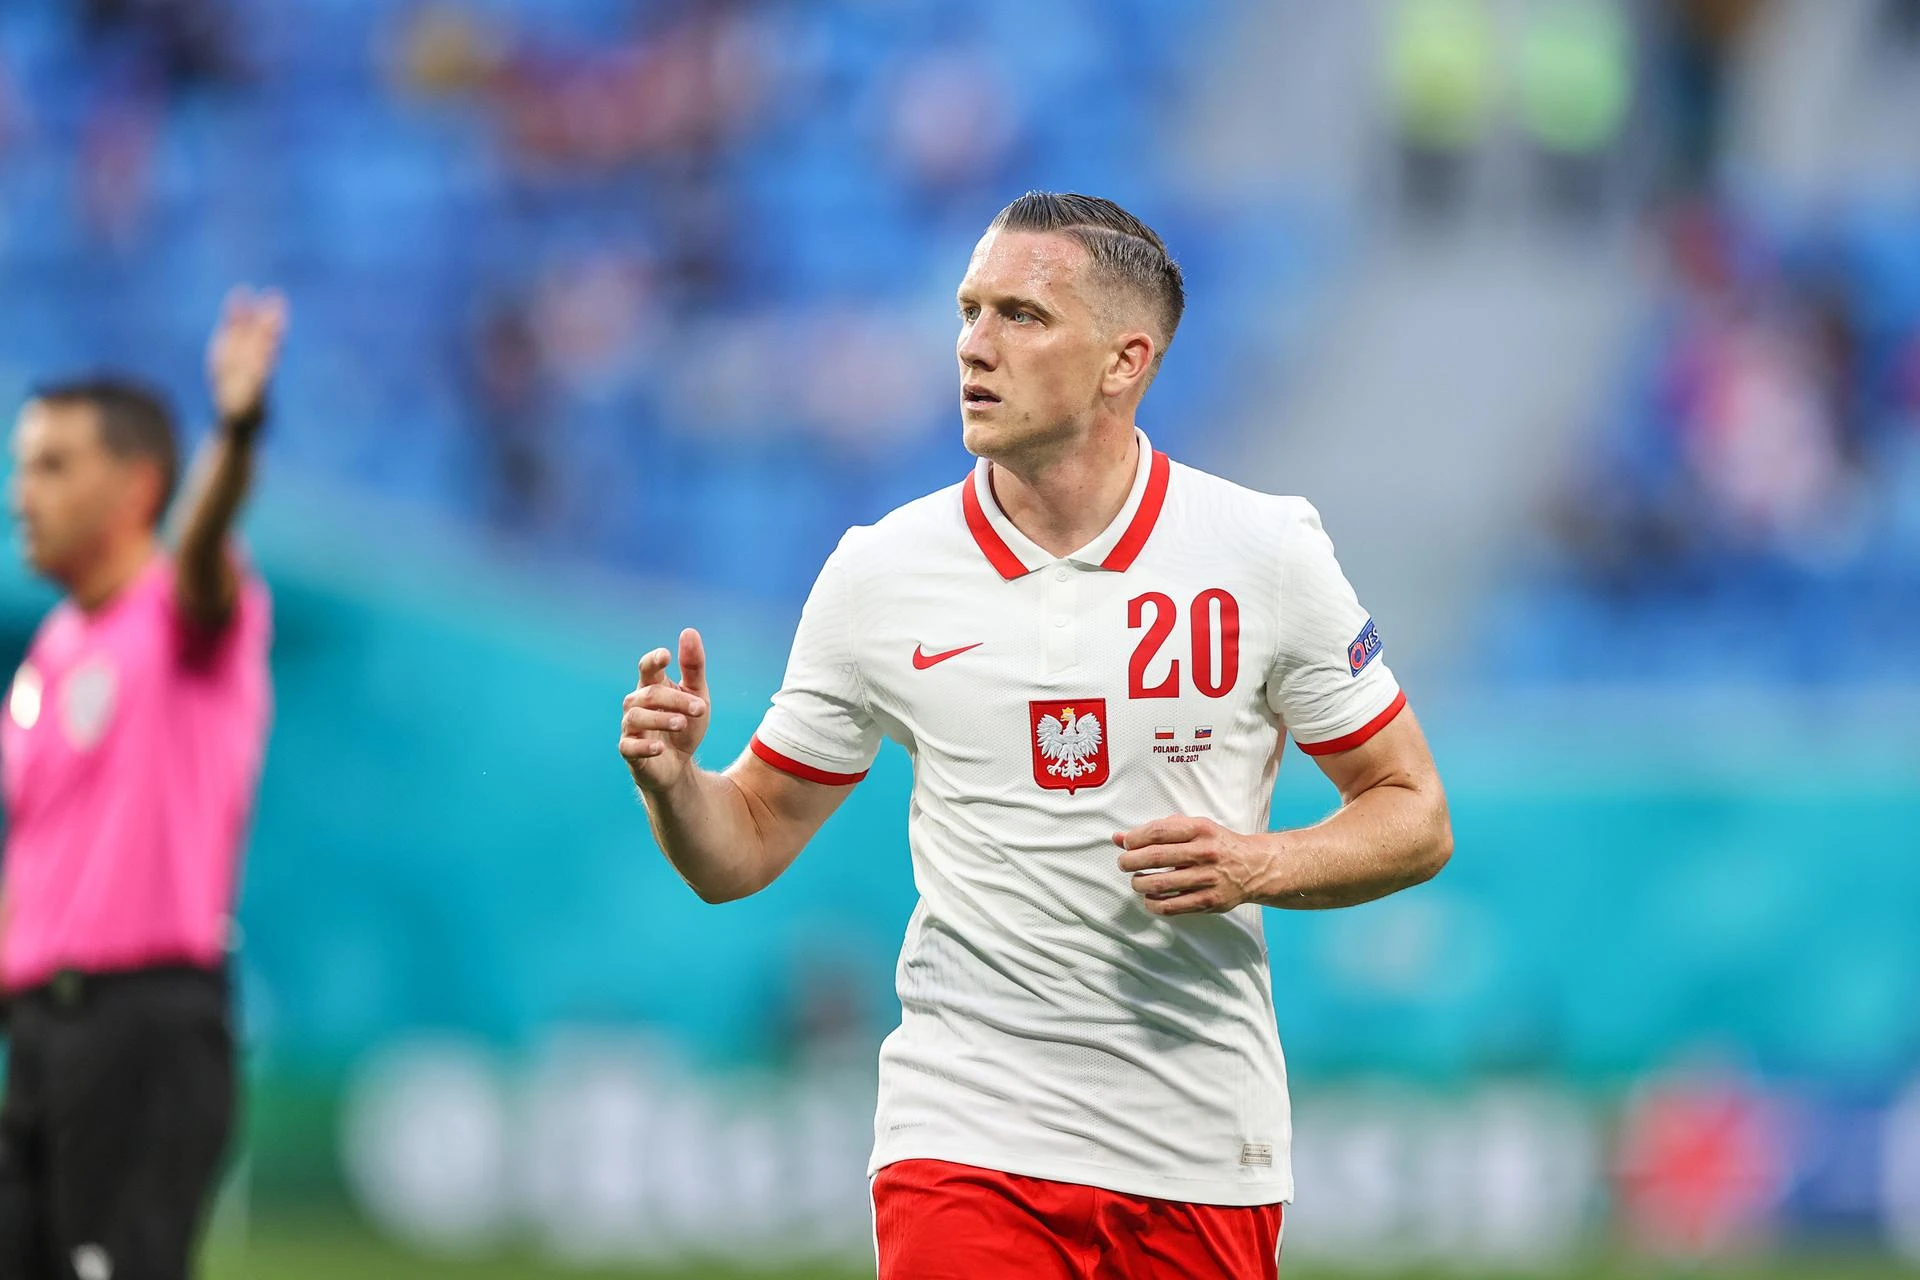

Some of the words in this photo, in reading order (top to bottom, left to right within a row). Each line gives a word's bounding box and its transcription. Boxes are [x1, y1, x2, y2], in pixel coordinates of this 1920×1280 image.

[1127, 588, 1240, 699] 20
[1363, 627, 1380, 655] RES
[1153, 745, 1180, 753] POLAND
[1185, 744, 1211, 753] SLOVAKIA
[1167, 754, 1199, 763] 14.06.2021
